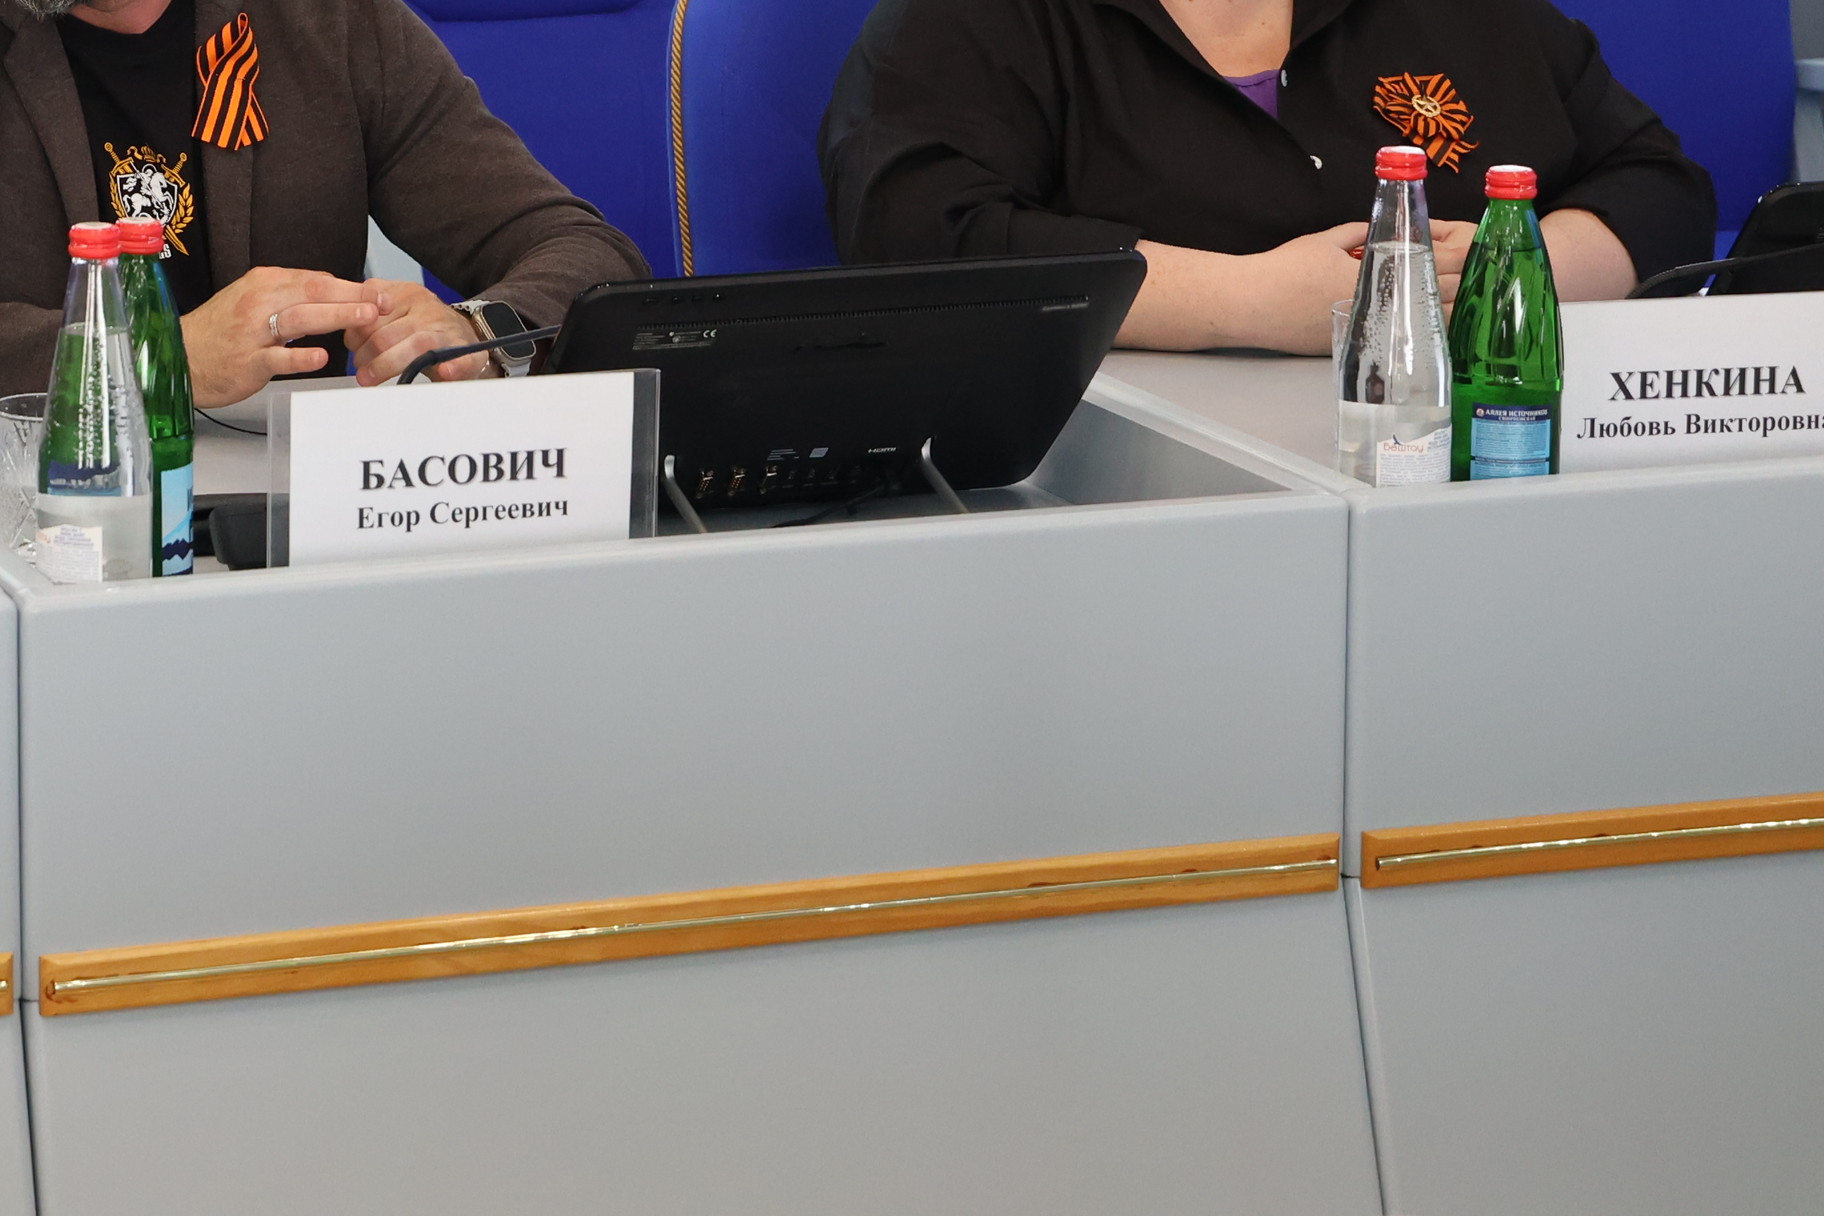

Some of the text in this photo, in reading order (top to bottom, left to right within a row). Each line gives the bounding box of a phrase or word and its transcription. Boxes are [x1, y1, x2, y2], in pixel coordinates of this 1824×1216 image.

[1608, 365, 1807, 401] ХЕНКИНА
[1576, 413, 1824, 440] Любовь Викторовн
[360, 448, 567, 491] БАСОВИЧ
[357, 499, 569, 533] Егор Сергеевич
